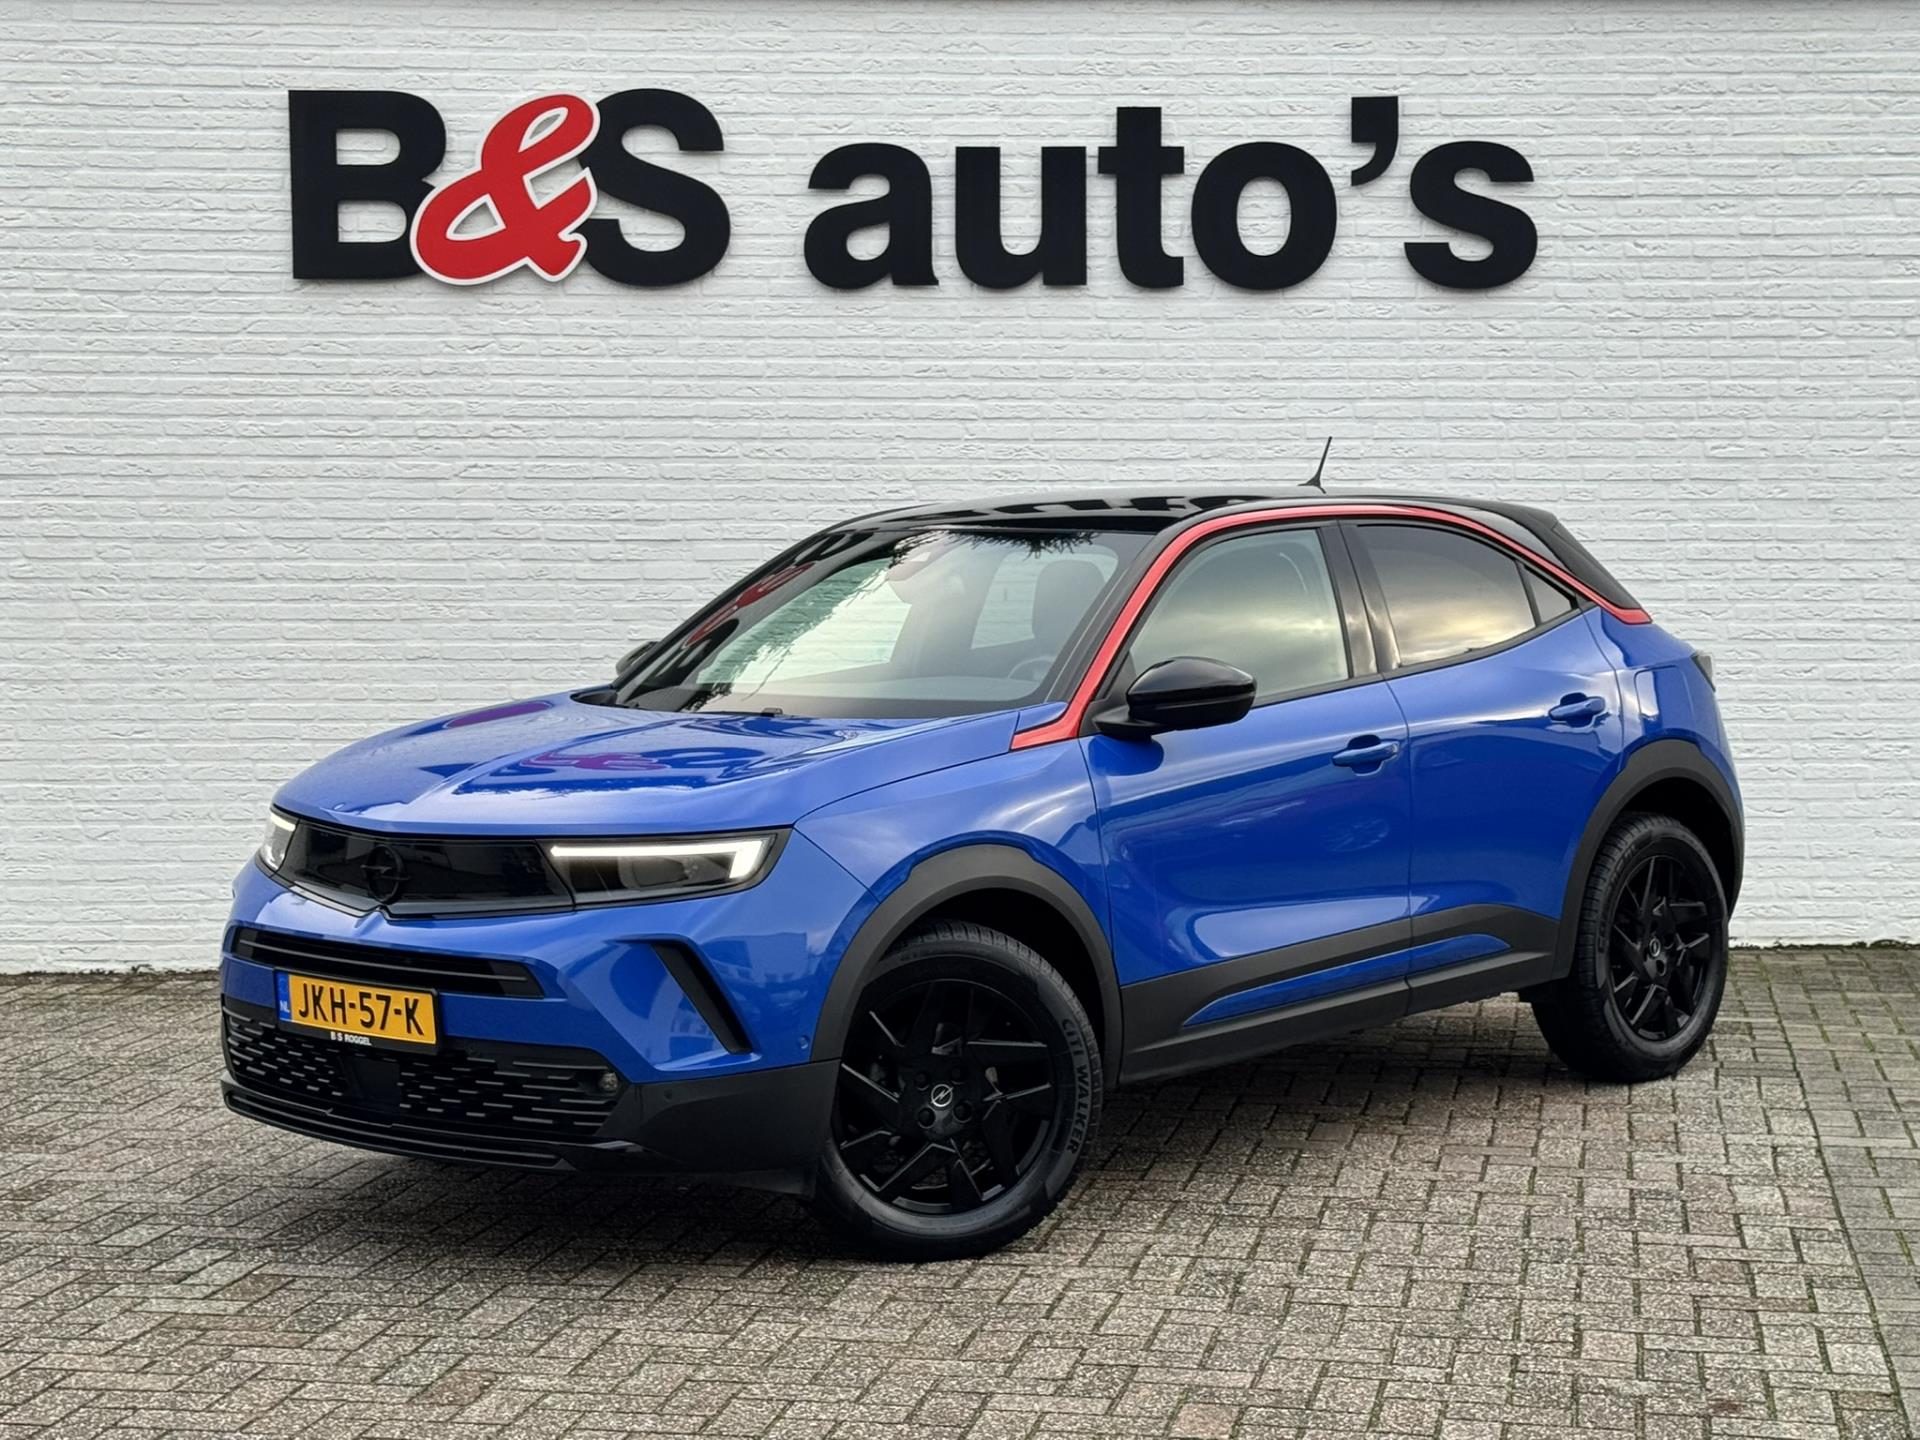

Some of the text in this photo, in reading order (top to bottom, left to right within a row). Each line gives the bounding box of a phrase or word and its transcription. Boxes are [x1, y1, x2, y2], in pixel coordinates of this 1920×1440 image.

[288, 88, 1538, 290] B&S auto's
[279, 1000, 290, 1013] NL
[299, 983, 424, 1035] JKH-57-K
[1062, 1018, 1090, 1154] CITI WALKER
